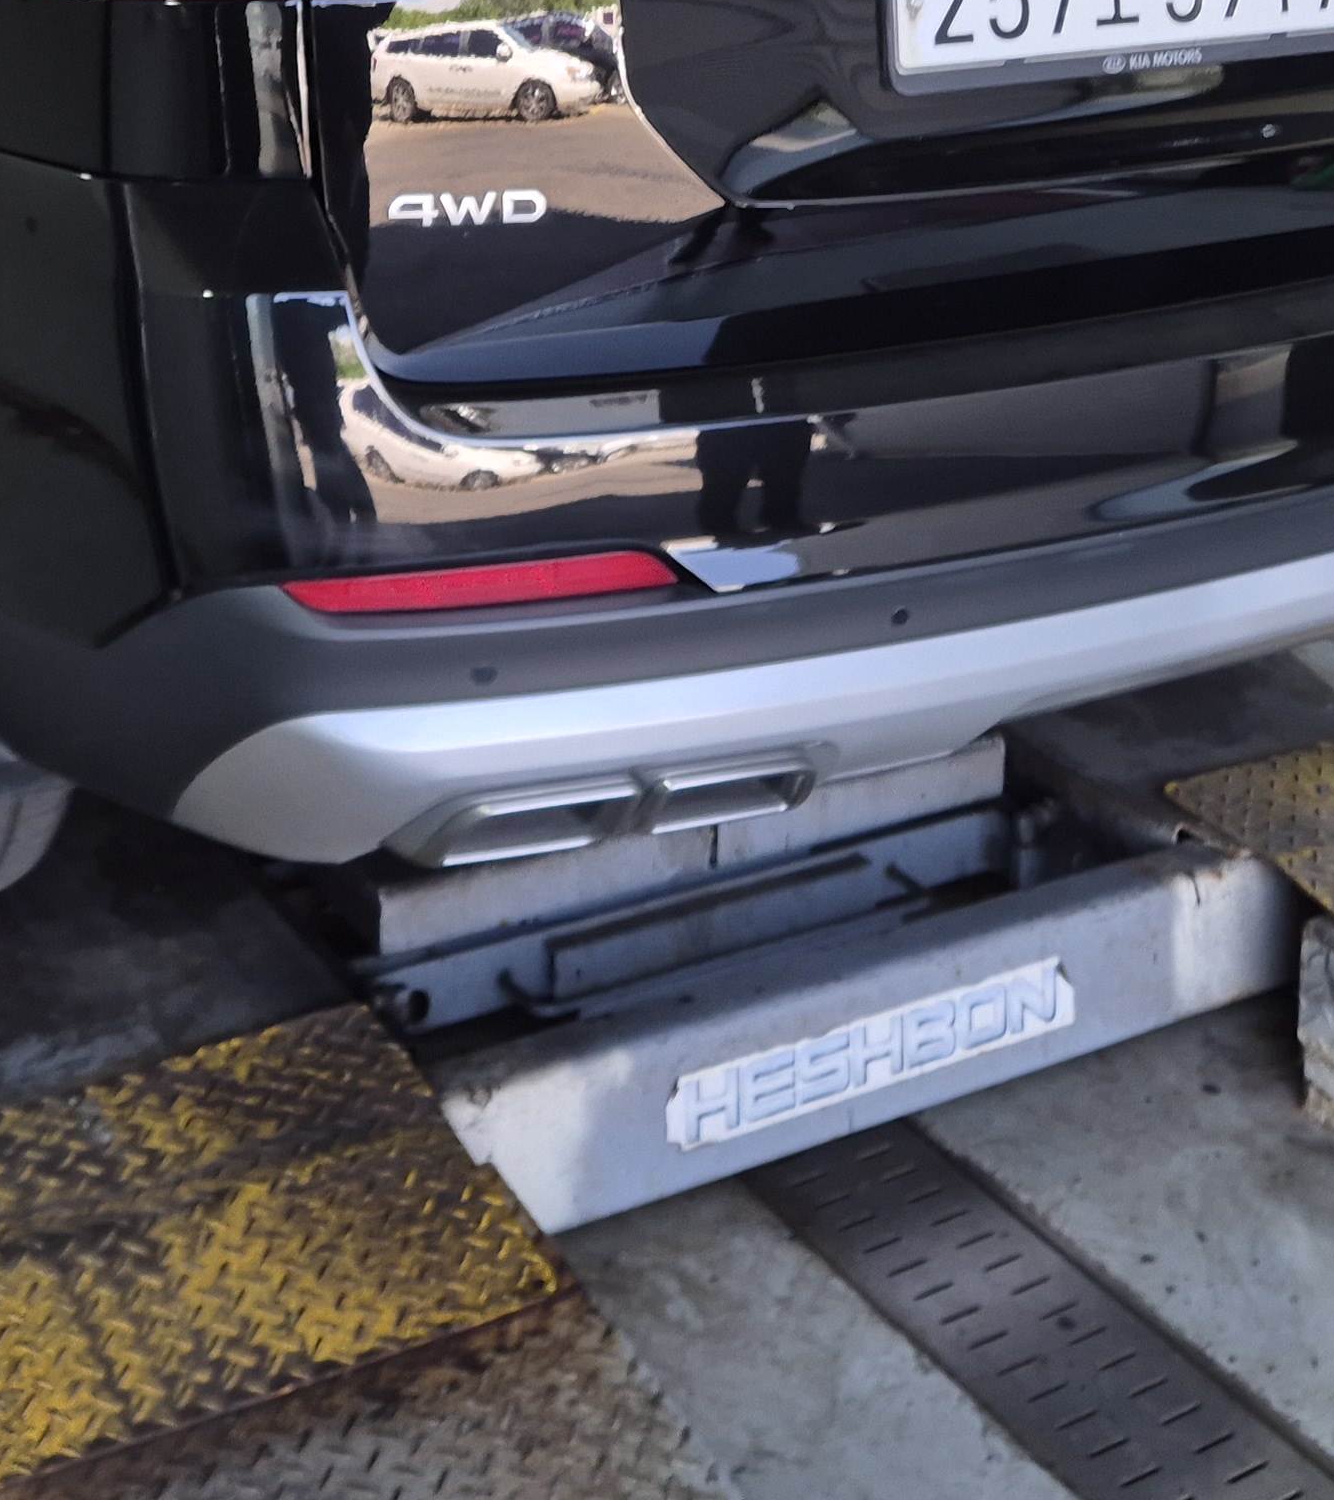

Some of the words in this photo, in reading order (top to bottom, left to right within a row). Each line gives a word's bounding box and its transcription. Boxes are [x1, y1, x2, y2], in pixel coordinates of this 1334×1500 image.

[1129, 52, 1151, 71] KIA
[1153, 47, 1203, 68] MOTORS
[388, 189, 547, 227] 4WD
[682, 963, 1058, 1142] HESHBON
